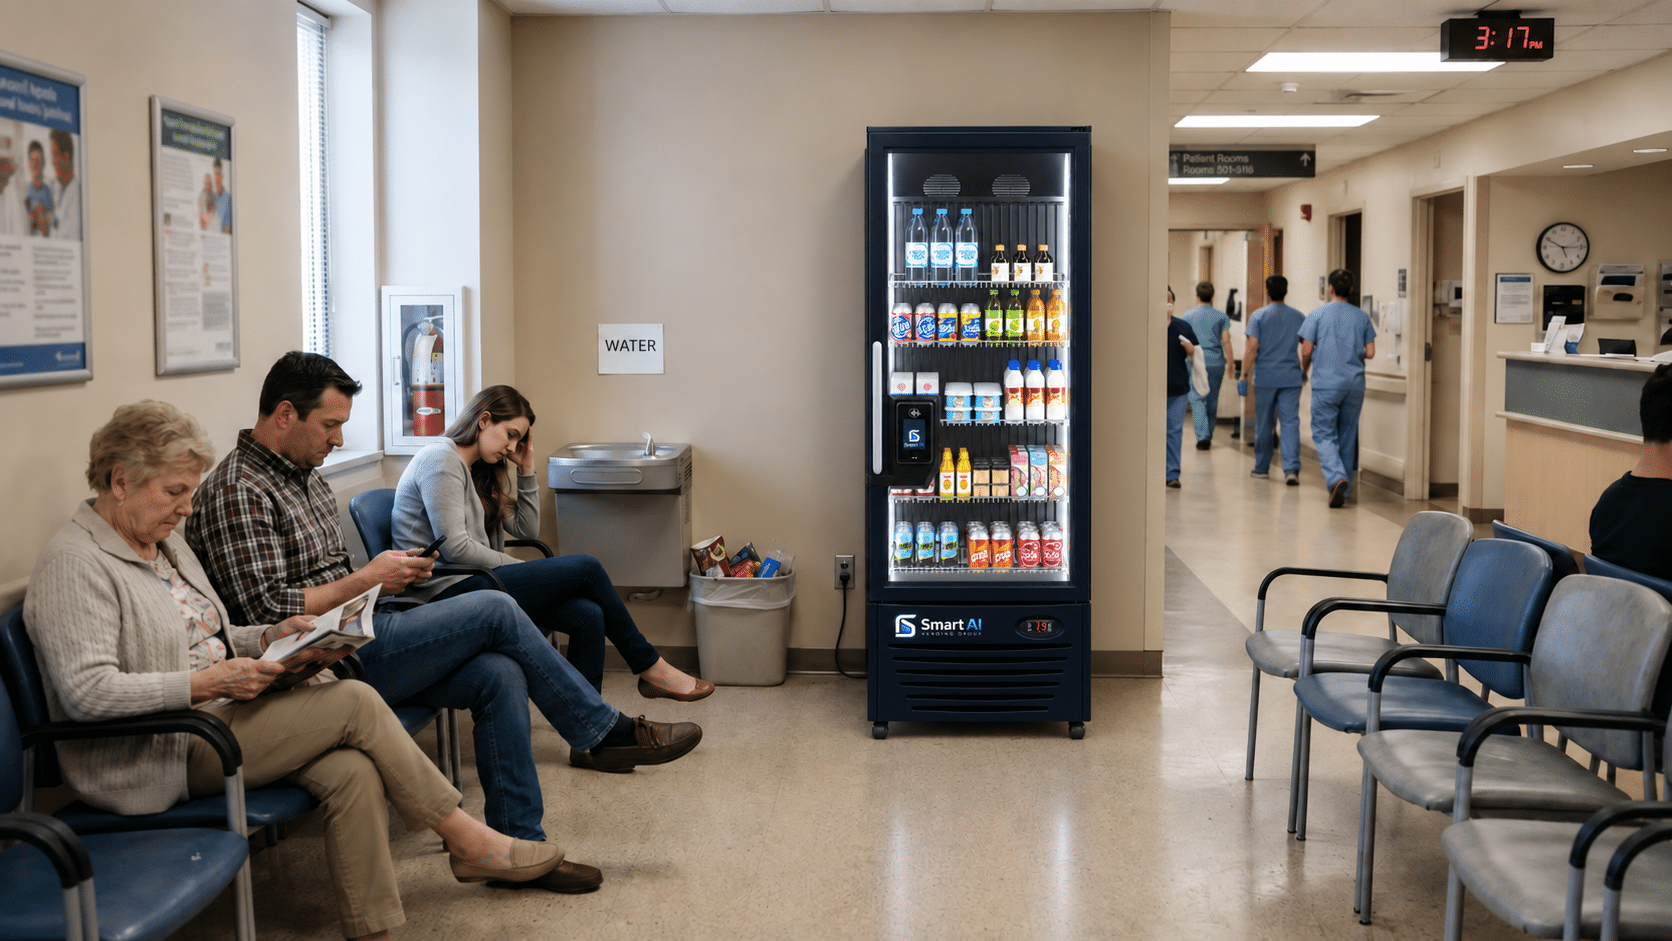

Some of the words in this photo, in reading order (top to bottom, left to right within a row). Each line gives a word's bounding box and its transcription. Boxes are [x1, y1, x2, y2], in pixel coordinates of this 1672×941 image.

[1475, 26, 1530, 50] 3:17
[1529, 40, 1543, 50] PM
[1183, 153, 1215, 163] Patient
[1217, 153, 1249, 163] Rooms
[1183, 165, 1214, 174] Rooms
[605, 339, 656, 352] WATER
[921, 618, 964, 631] Smart
[966, 618, 982, 631] AI
